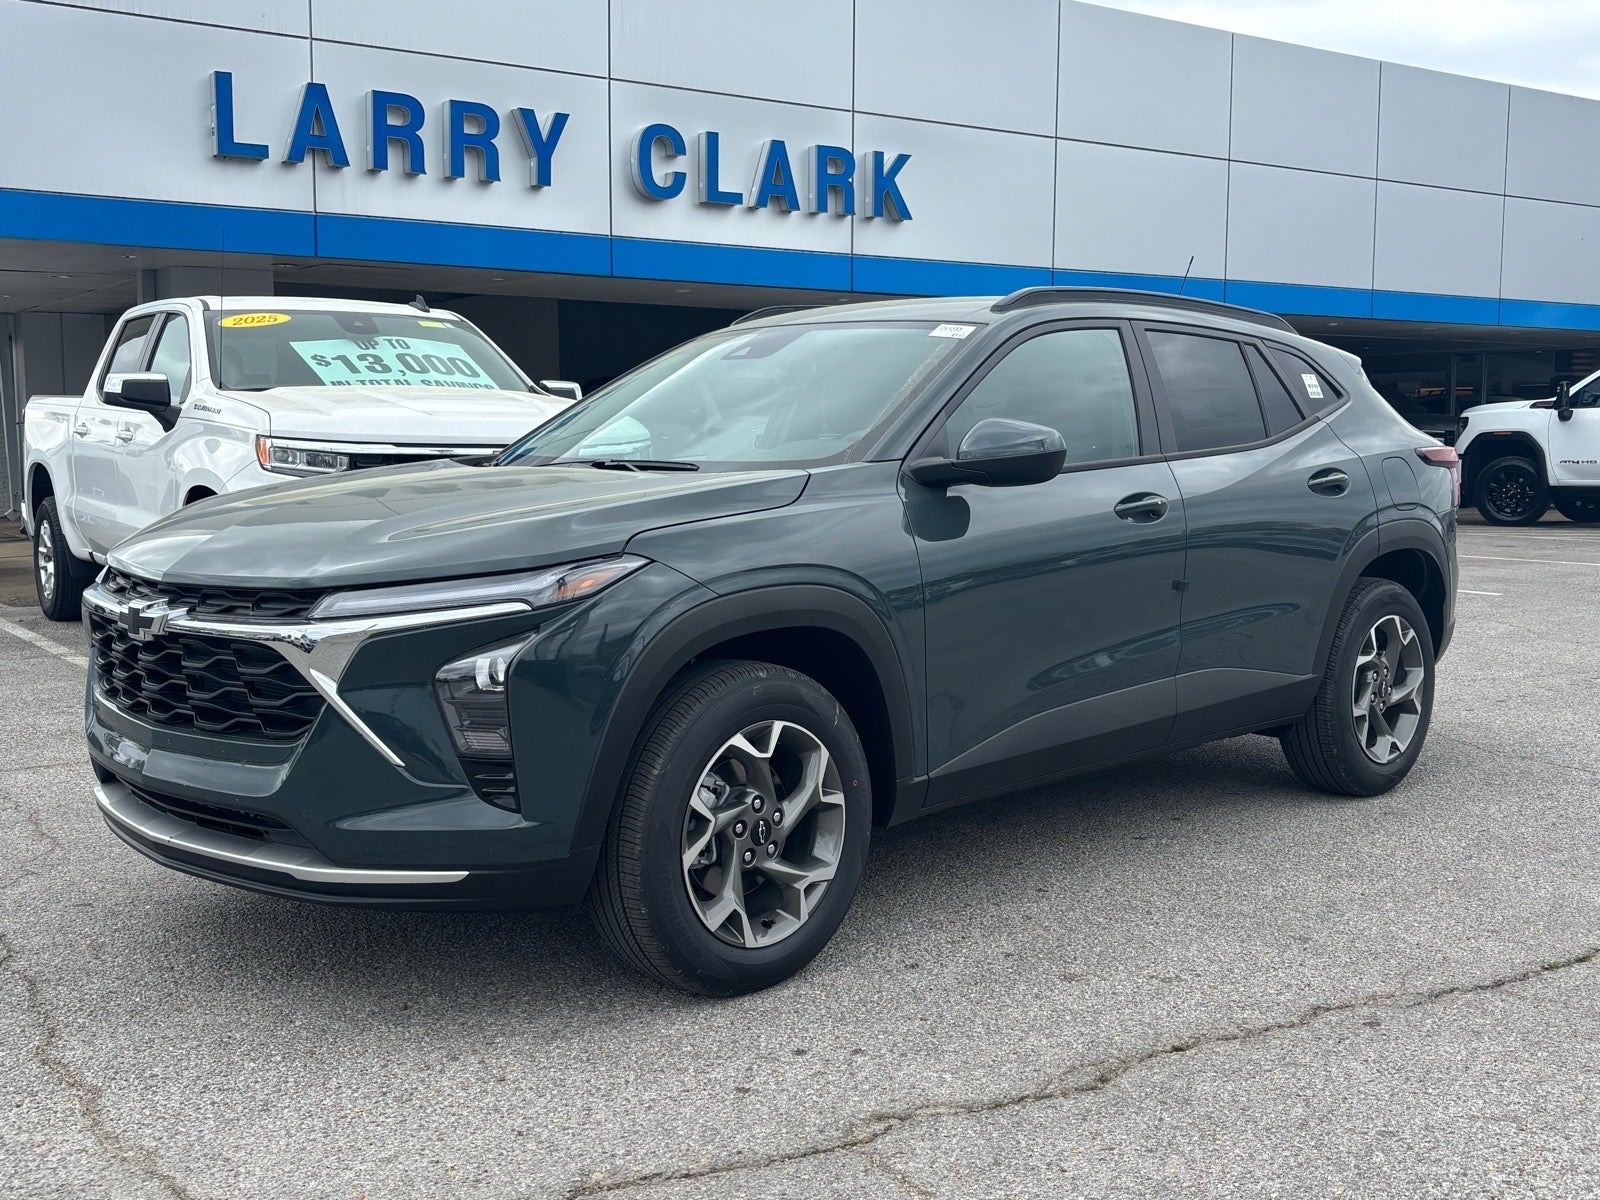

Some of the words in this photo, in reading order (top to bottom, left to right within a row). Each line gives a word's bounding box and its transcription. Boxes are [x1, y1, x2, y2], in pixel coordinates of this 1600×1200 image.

[211, 70, 570, 189] LARRY
[630, 122, 913, 222] CLARK
[232, 314, 278, 326] 2025
[353, 339, 380, 351] UP
[383, 338, 412, 351] TO
[310, 352, 481, 379] $13,000
